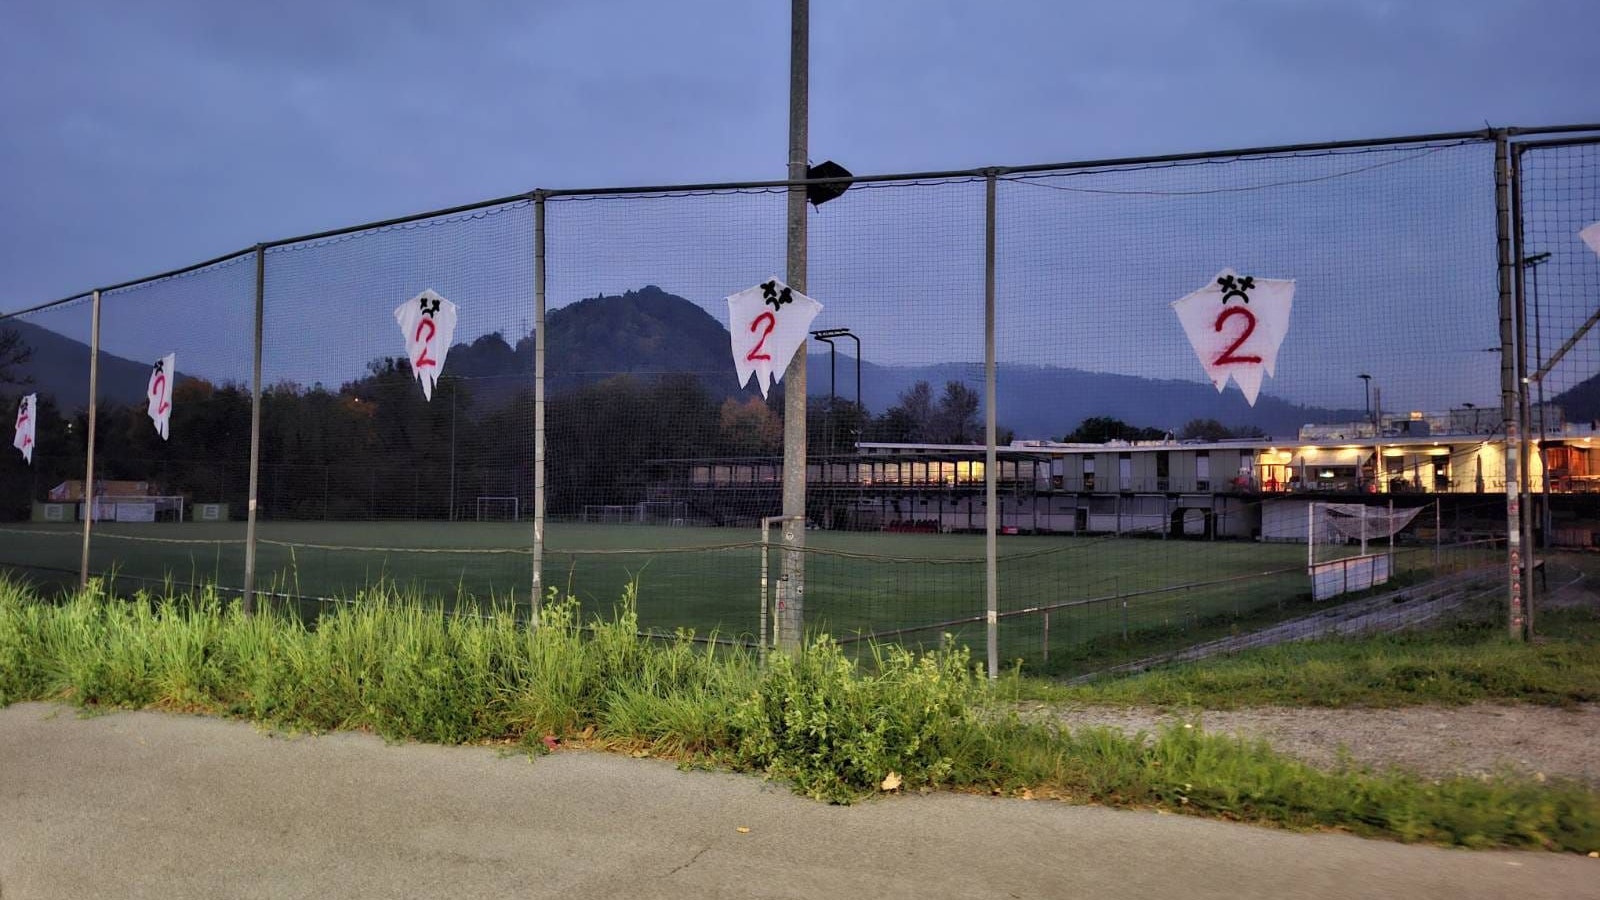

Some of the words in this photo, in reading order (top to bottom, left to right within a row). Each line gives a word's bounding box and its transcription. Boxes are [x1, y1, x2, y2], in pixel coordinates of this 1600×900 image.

[416, 318, 436, 367] 2
[747, 312, 775, 361] 2
[1213, 306, 1262, 366] 2
